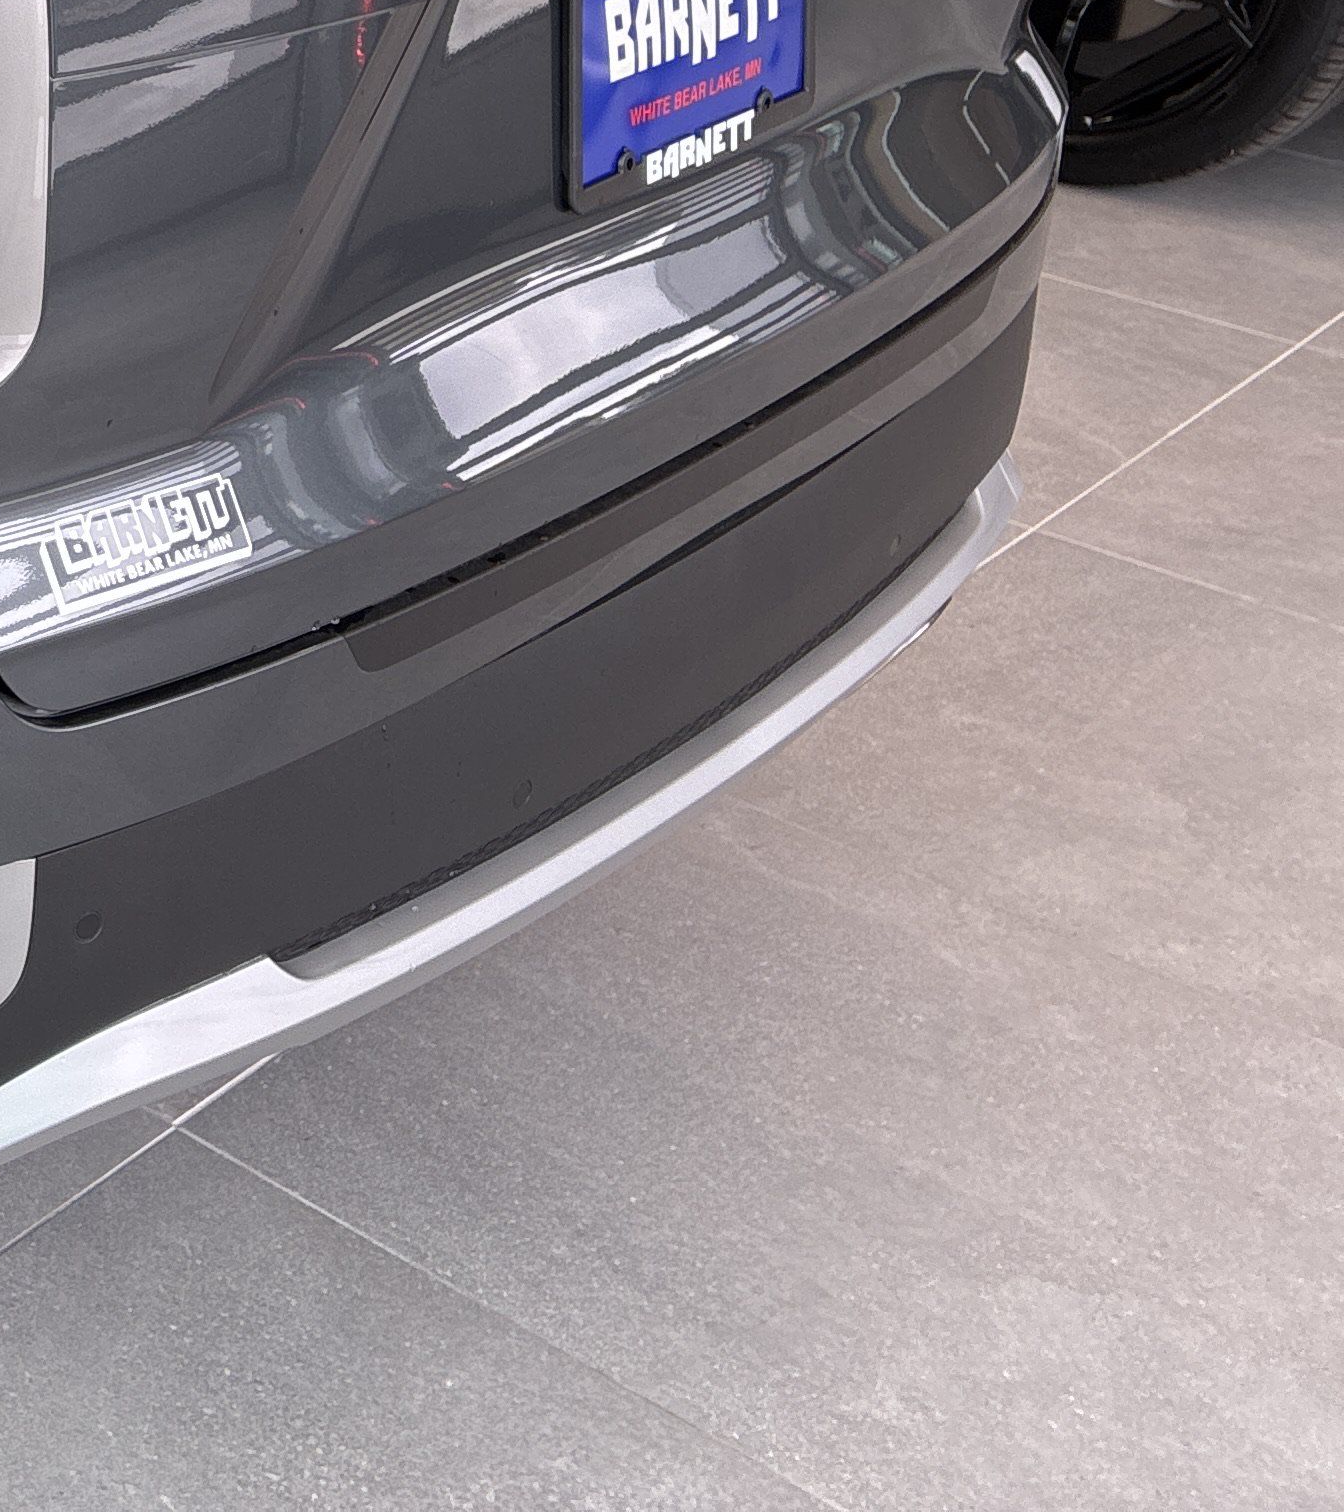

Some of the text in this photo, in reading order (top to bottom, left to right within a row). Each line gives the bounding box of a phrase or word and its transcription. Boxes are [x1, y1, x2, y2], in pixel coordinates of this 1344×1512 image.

[629, 57, 762, 127] WHITE BEAR LAKE, MN
[646, 108, 756, 185] BARNETT
[55, 474, 231, 576] BARNETT
[78, 533, 233, 593] WHITE BEAR LAKE, MN
